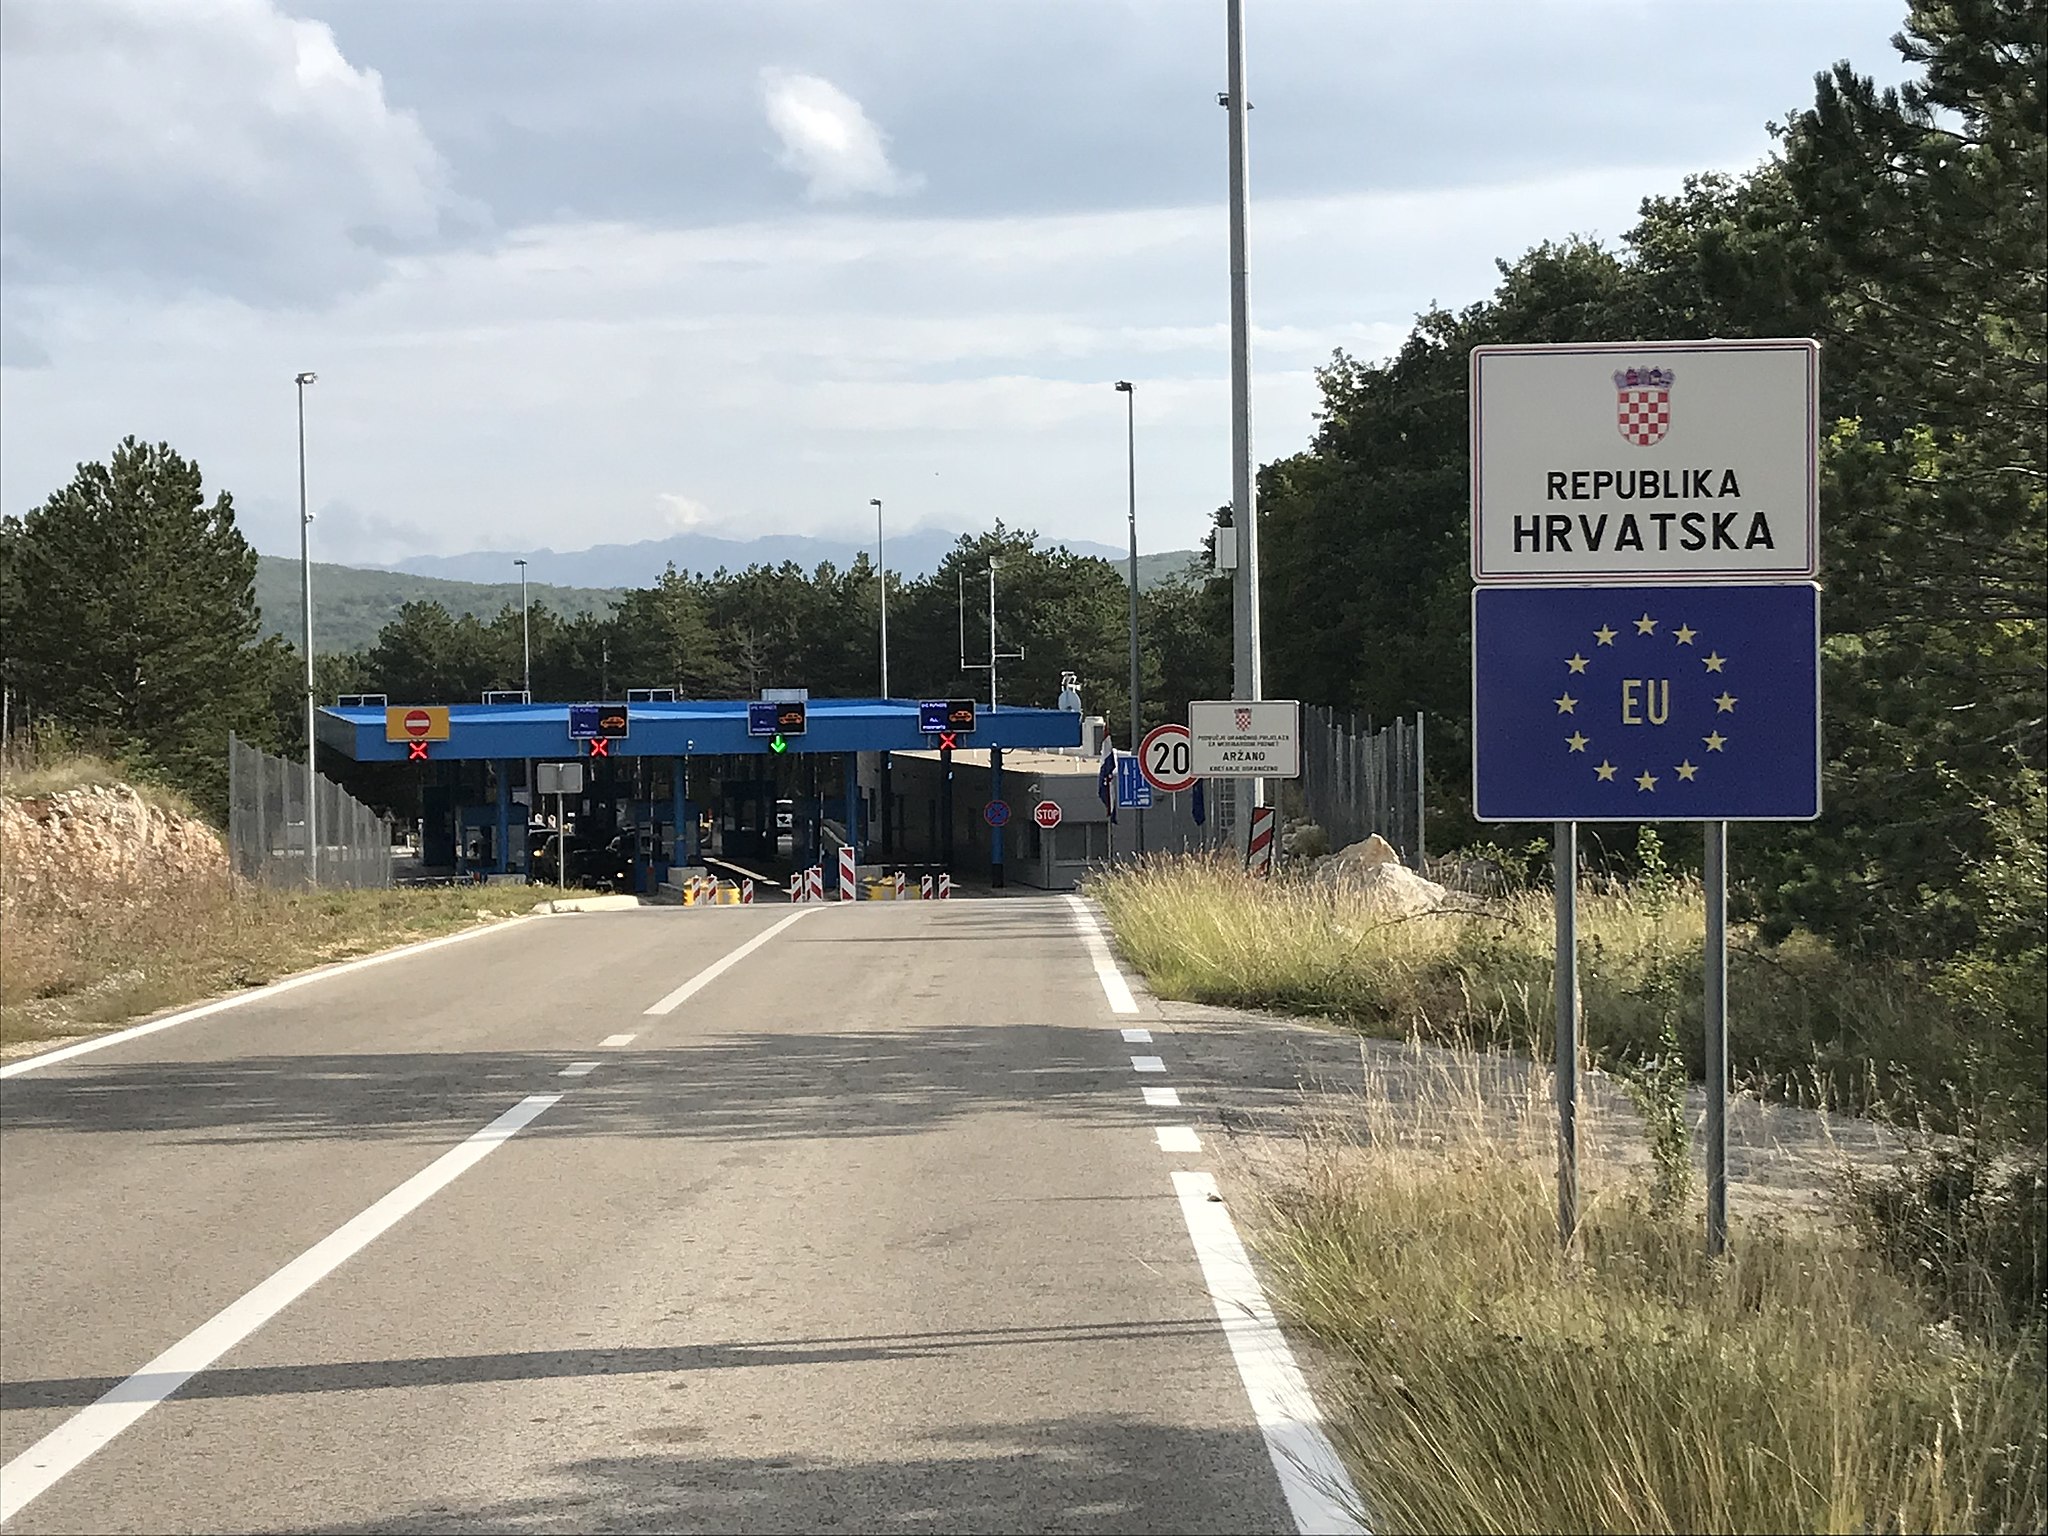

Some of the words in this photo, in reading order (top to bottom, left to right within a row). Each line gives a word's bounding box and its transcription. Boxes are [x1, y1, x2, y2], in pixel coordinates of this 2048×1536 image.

[1547, 469, 1741, 500] REPUBLIKA
[1513, 511, 1775, 552] HRVATSKA
[1622, 679, 1669, 725] EU
[1153, 742, 1190, 775] 20
[1222, 749, 1266, 761] ARŽANO
[1036, 809, 1058, 820] STOP
